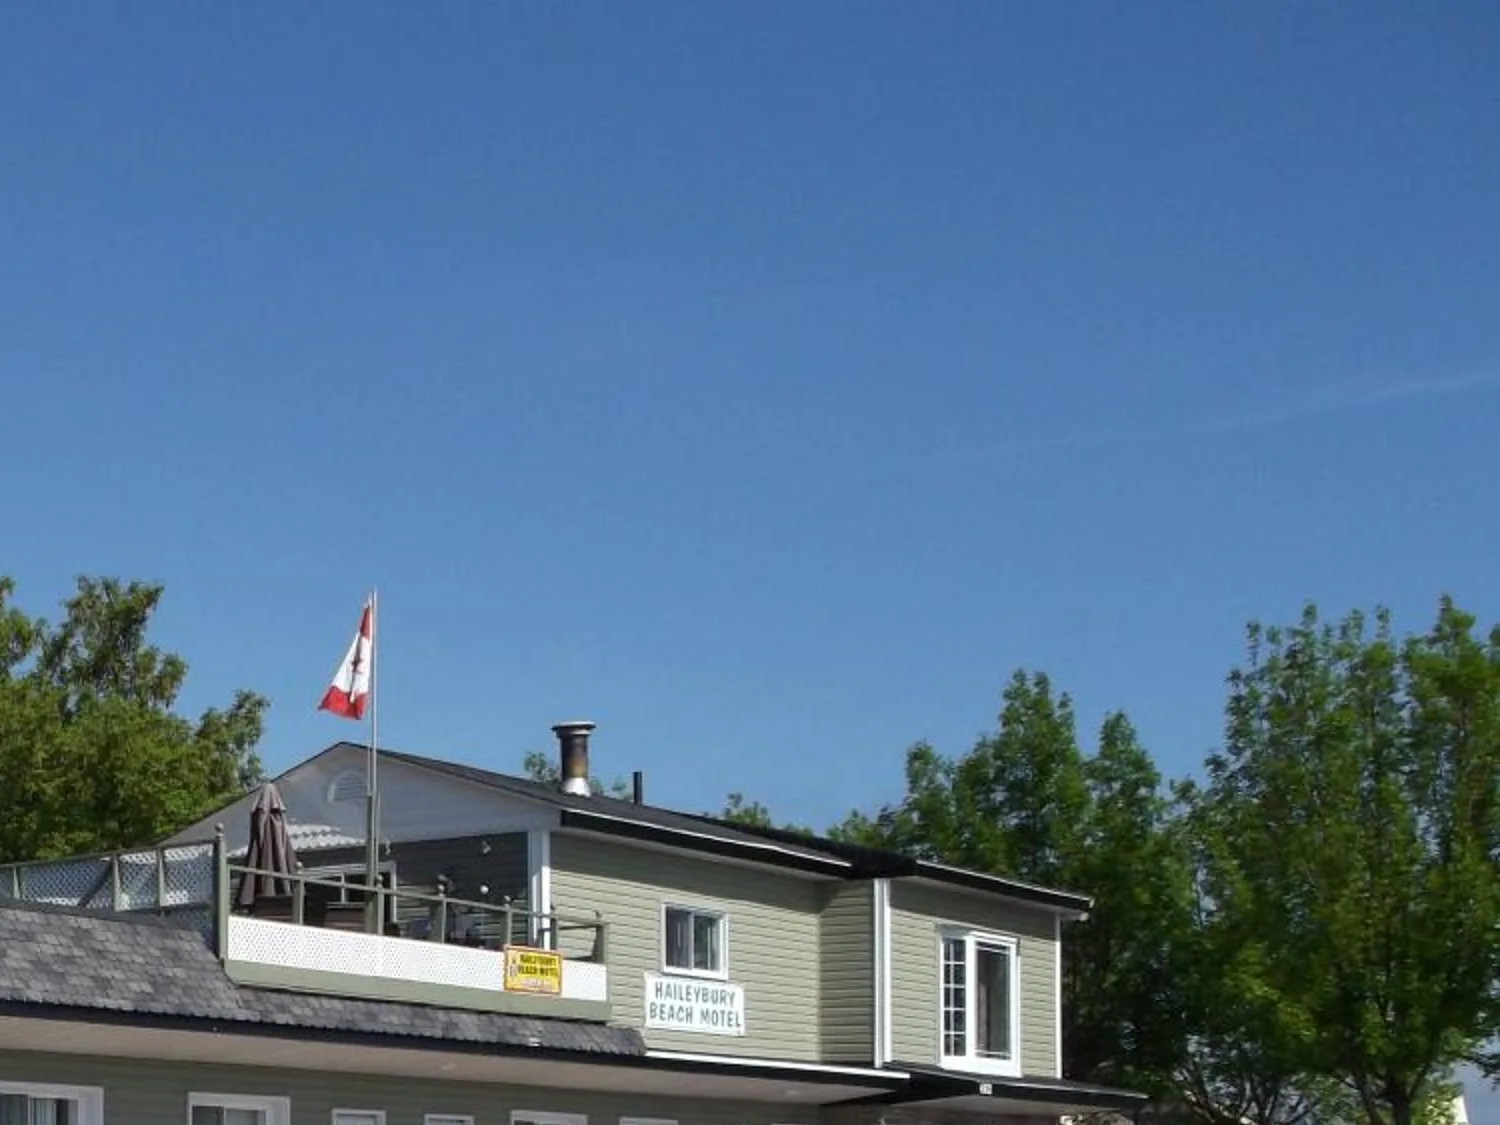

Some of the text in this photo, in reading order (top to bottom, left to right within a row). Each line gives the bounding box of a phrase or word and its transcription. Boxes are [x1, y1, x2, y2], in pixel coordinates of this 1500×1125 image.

[655, 981, 735, 1006] HAILEYBURY
[650, 1001, 741, 1027] BEACH MOTEL
